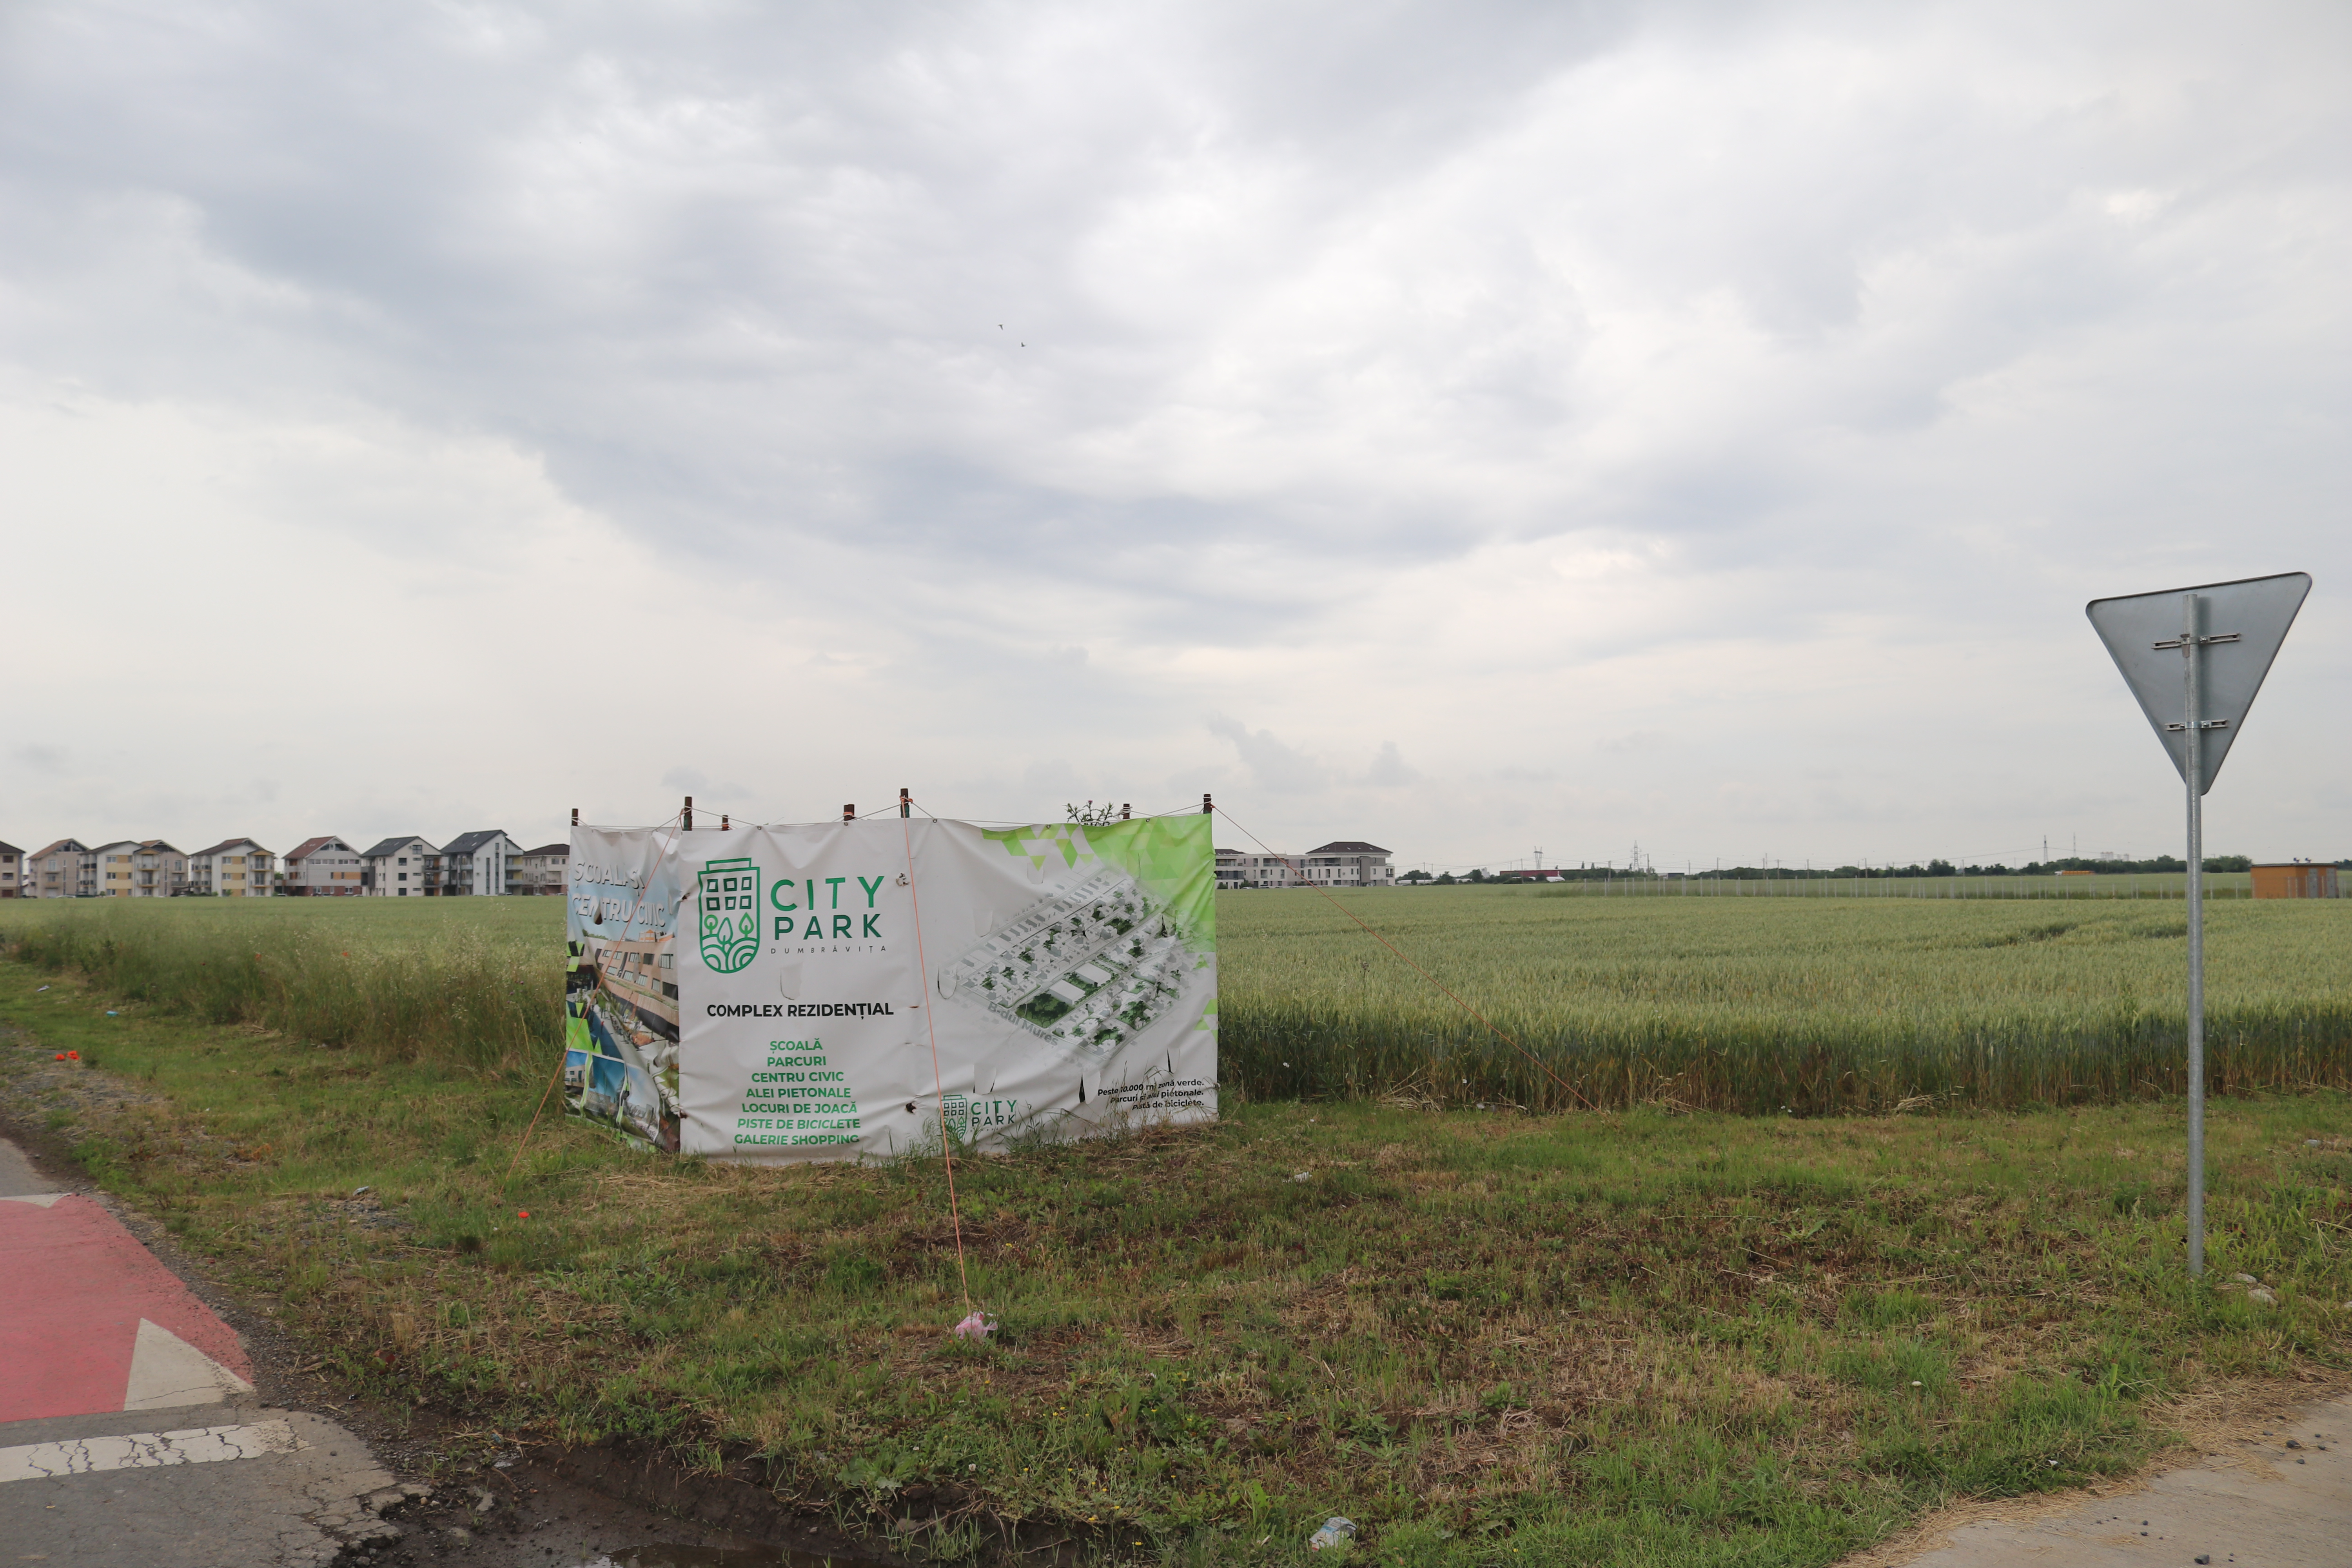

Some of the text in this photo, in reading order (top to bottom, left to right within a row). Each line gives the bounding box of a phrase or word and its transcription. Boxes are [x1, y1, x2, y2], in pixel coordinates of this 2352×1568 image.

[574, 862, 628, 888] ȘCOAL
[770, 875, 885, 911] CITY
[637, 902, 666, 927] CIVIC
[774, 914, 882, 940] PARK
[771, 945, 886, 954] DUMBRĂVIȚA
[707, 1002, 894, 1020] COMPLEX REZIDENȚIAL
[987, 1001, 1020, 1025] B-dul
[769, 1038, 823, 1054] ȘCOALĂ
[767, 1056, 826, 1067] PARCURI
[751, 1072, 844, 1083] CENTRU CIVIC
[746, 1088, 851, 1098] ALEI PIETONALE
[1098, 1088, 1119, 1096] Peste
[1120, 1084, 1143, 1093] 10.000
[1158, 1079, 1174, 1089] zonă
[1140, 1093, 1146, 1102] și
[1147, 1091, 1160, 1099] alei
[1161, 1089, 1204, 1098] pietonale.
[742, 1102, 857, 1114] LOCURI DE JOACĂ
[971, 1100, 1017, 1115] CITY
[1165, 1099, 1204, 1108] biciclete.
[737, 1119, 860, 1130] PISTE DE BICICLETE
[972, 1114, 1015, 1127] PARK
[734, 1134, 860, 1145] GALERIE SHOPPING
